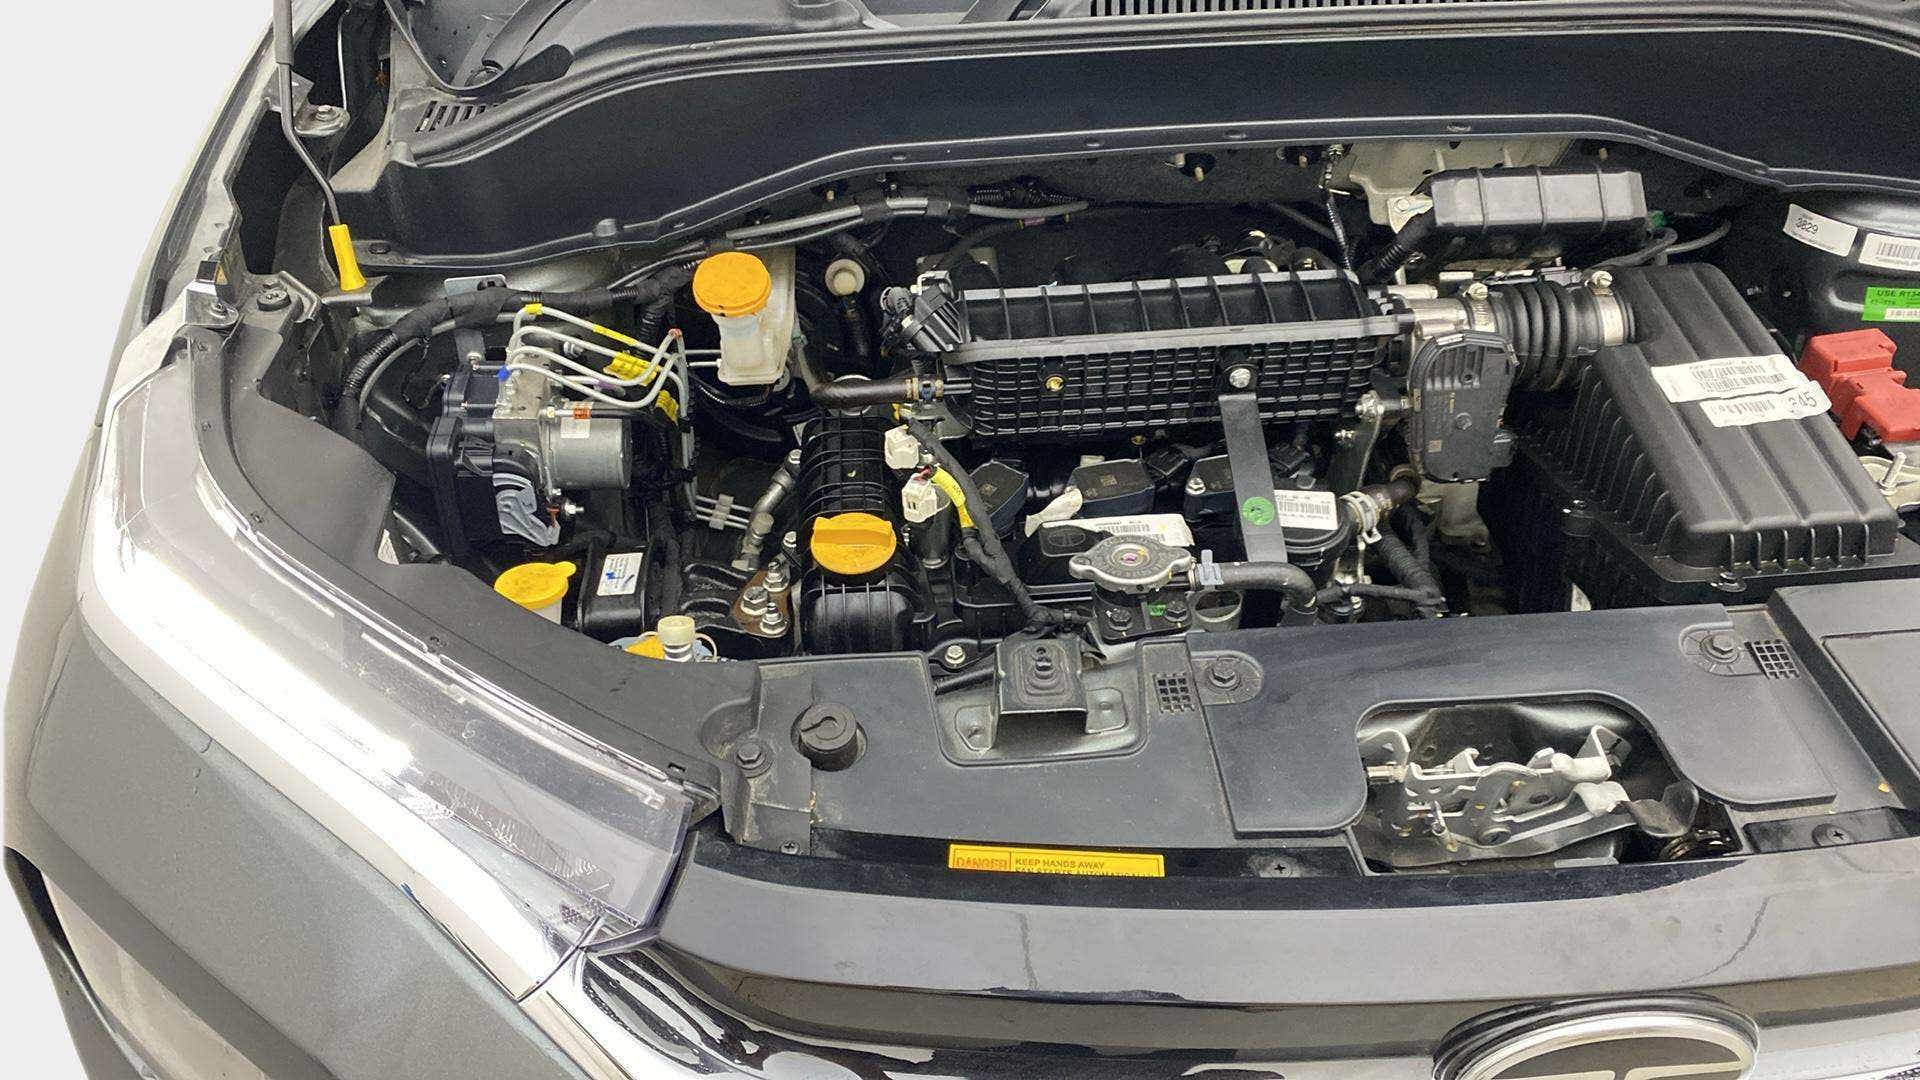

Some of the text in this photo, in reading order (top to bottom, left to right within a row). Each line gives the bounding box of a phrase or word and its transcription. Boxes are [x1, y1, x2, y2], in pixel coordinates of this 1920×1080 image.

[1015, 858, 1105, 869] KEEP HANDS AWAY
